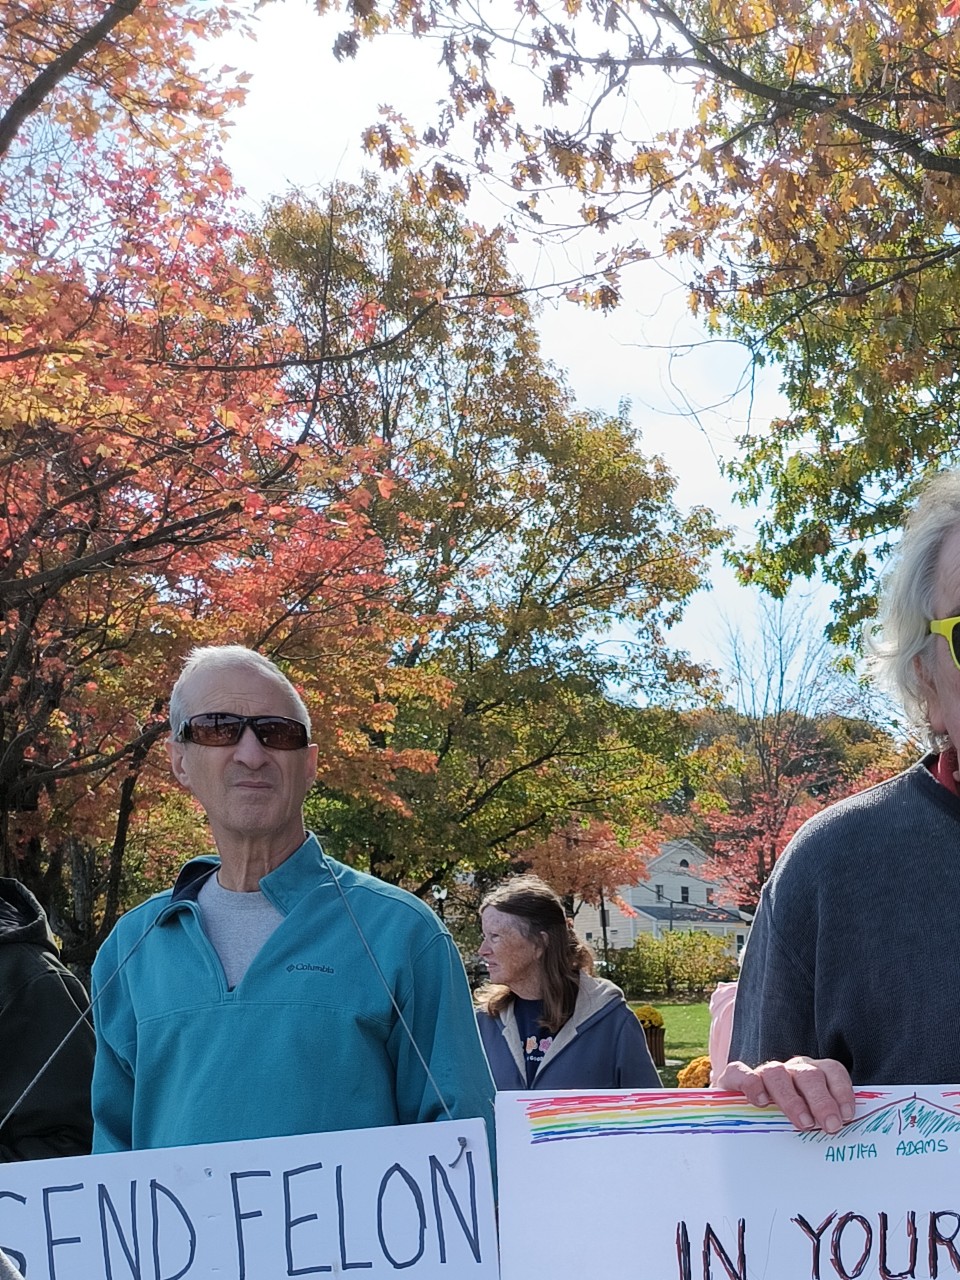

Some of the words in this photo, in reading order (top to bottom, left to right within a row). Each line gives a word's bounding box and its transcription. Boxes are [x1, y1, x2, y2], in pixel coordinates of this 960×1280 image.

[295, 962, 335, 974] Columbia
[825, 1142, 878, 1162] ANTIFA
[896, 1138, 949, 1157] ADAMS
[230, 1150, 482, 1280] FELON
